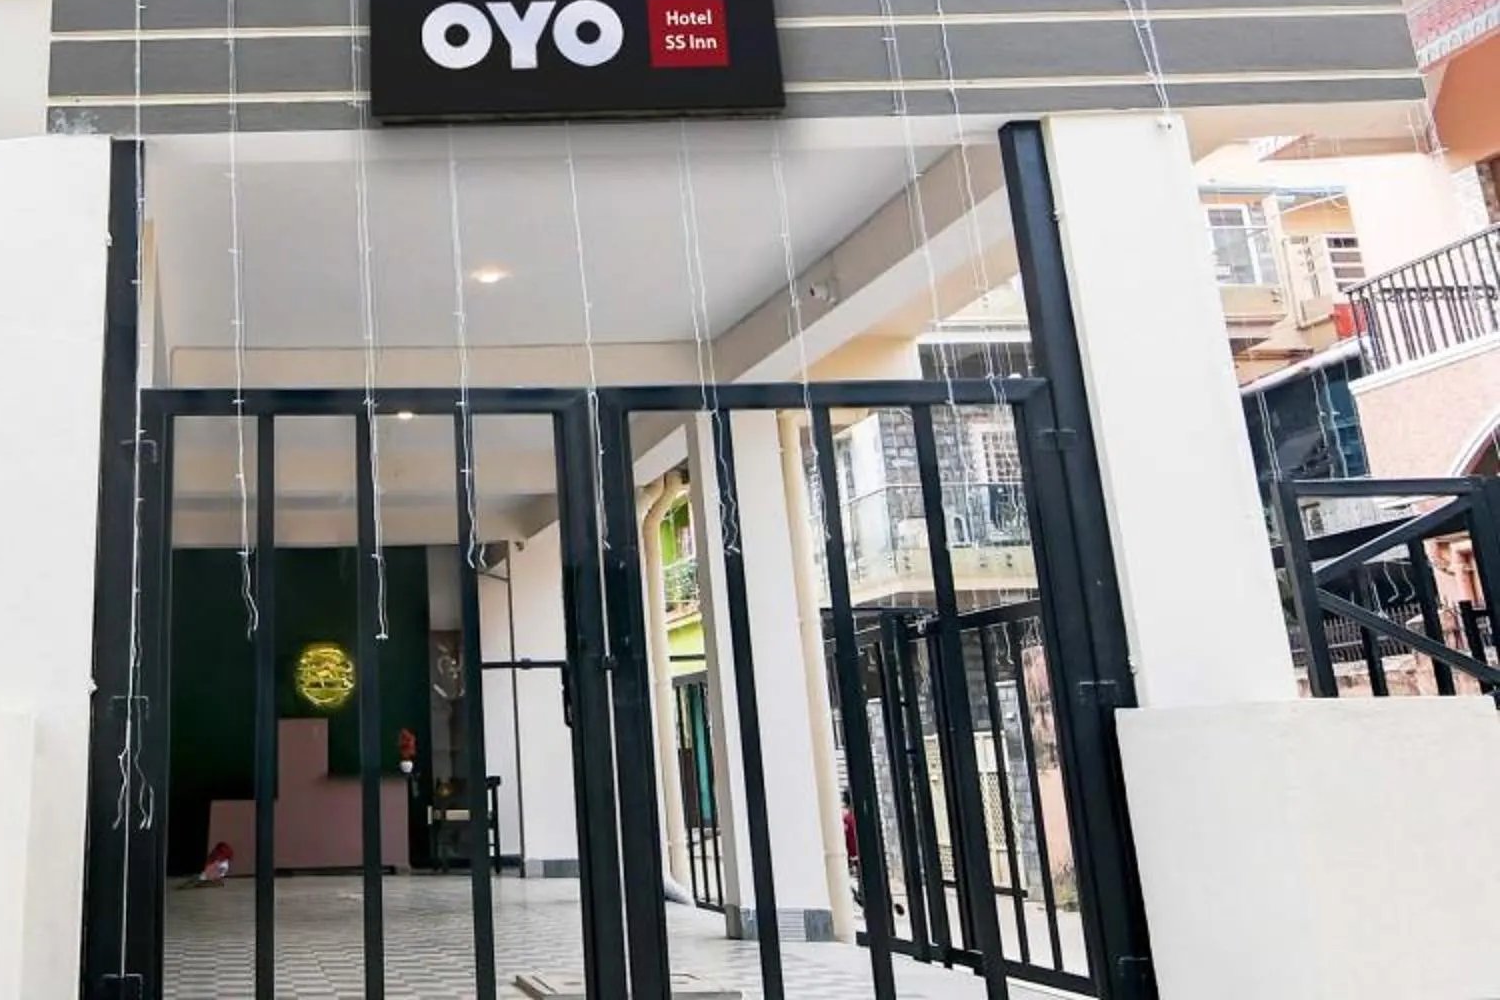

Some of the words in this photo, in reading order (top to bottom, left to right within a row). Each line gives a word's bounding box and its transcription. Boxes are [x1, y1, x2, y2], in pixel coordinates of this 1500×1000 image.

[665, 8, 713, 26] Hotel
[421, 0, 624, 69] OYO
[665, 33, 687, 50] SS
[689, 33, 718, 50] Inn
